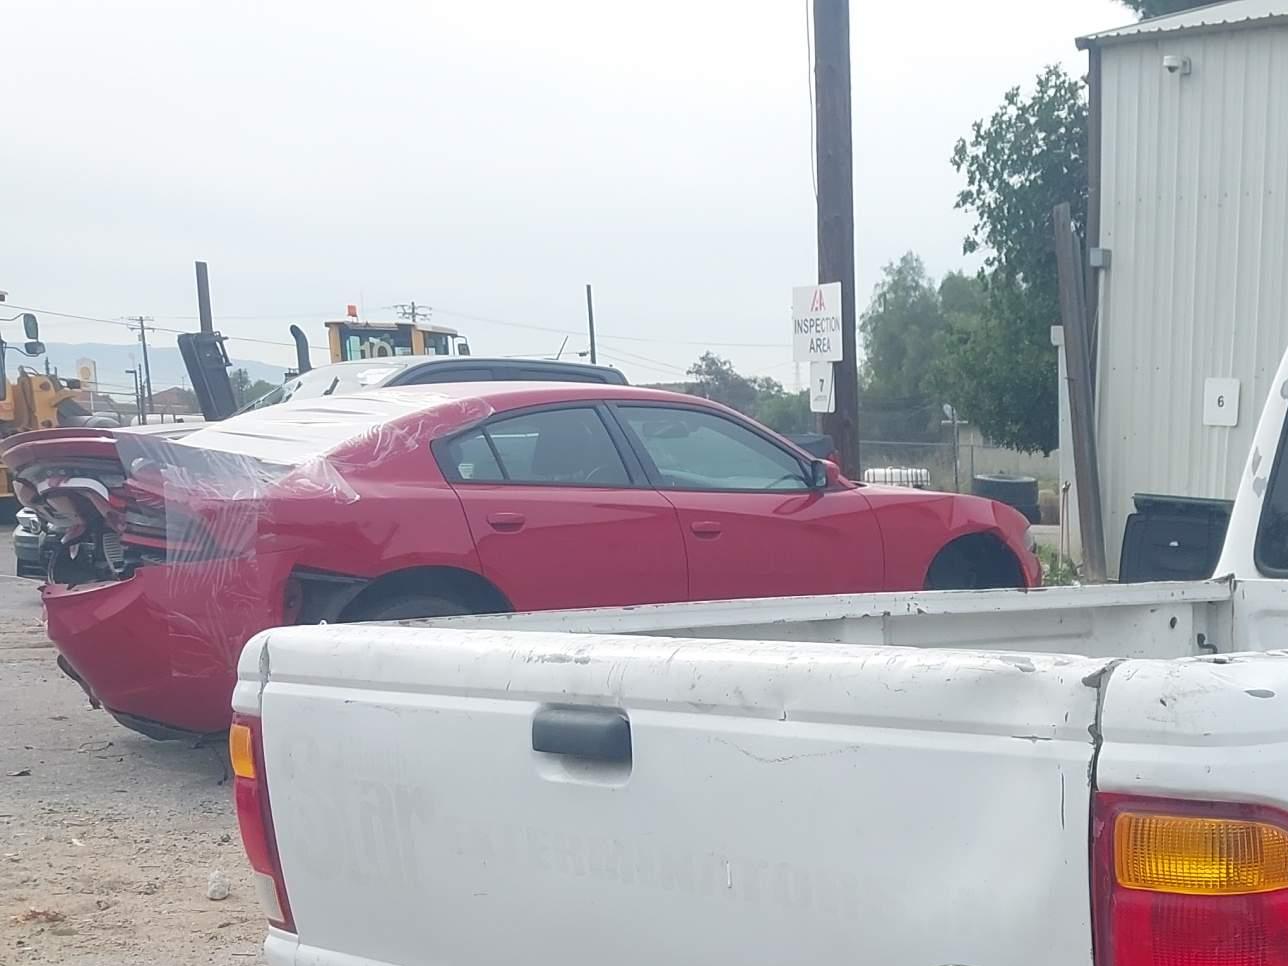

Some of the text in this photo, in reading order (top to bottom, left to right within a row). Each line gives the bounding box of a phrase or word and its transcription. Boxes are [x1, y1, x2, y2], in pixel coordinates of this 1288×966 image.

[794, 317, 841, 335] INSPECTION
[809, 337, 832, 353] AREA
[819, 379, 825, 392] 7
[1217, 395, 1225, 408] 6
